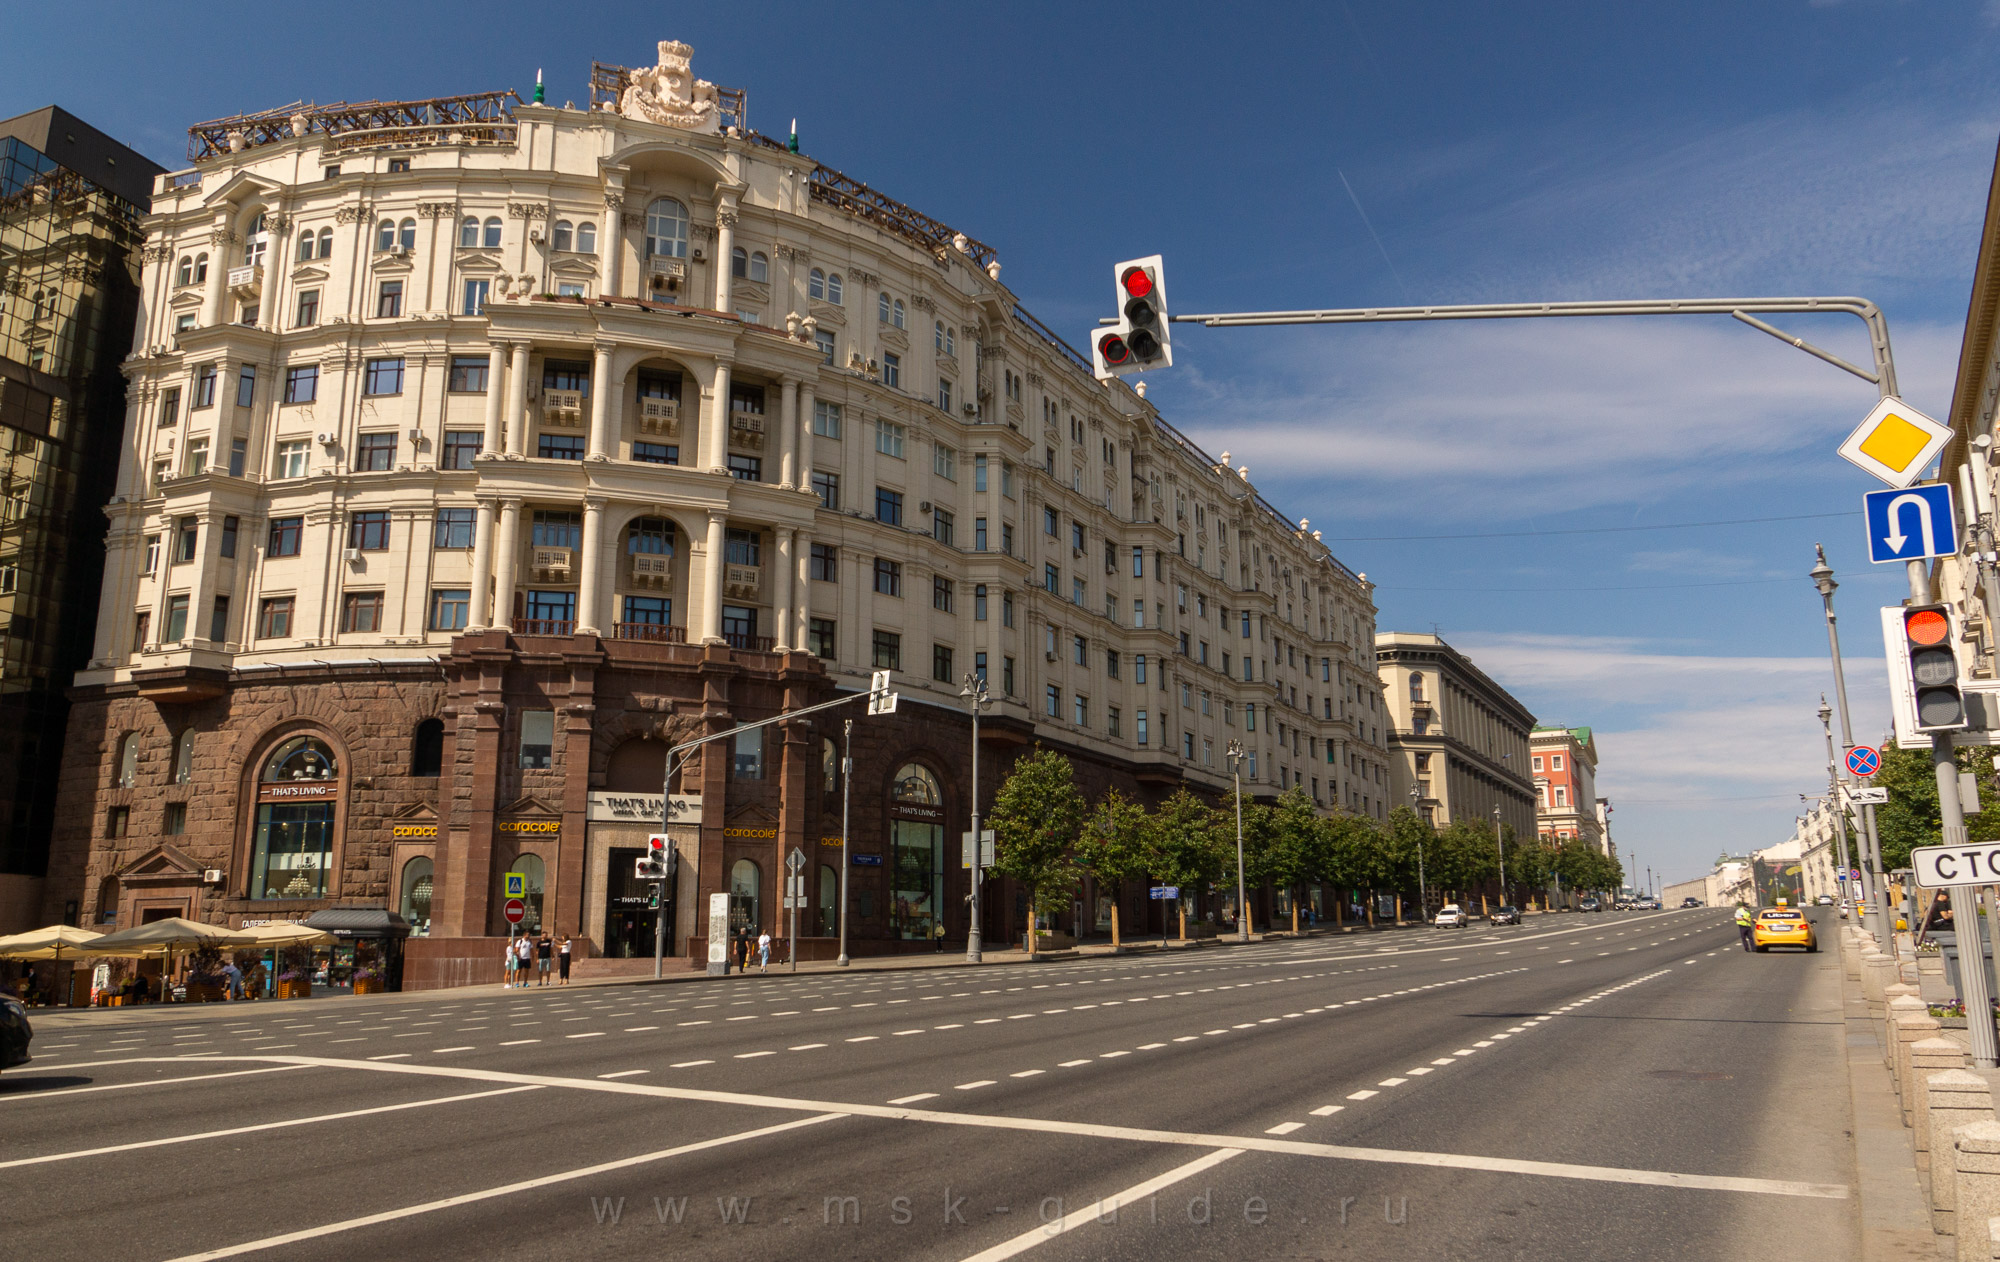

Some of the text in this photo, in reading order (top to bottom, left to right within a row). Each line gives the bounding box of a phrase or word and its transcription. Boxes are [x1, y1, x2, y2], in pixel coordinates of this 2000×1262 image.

[272, 787, 326, 796] THAT'S LIVING
[606, 797, 686, 809] THAT'S LIVNG
[900, 807, 936, 817] THAT'S LIVING
[500, 820, 560, 832] caracole
[723, 827, 776, 839] caracole
